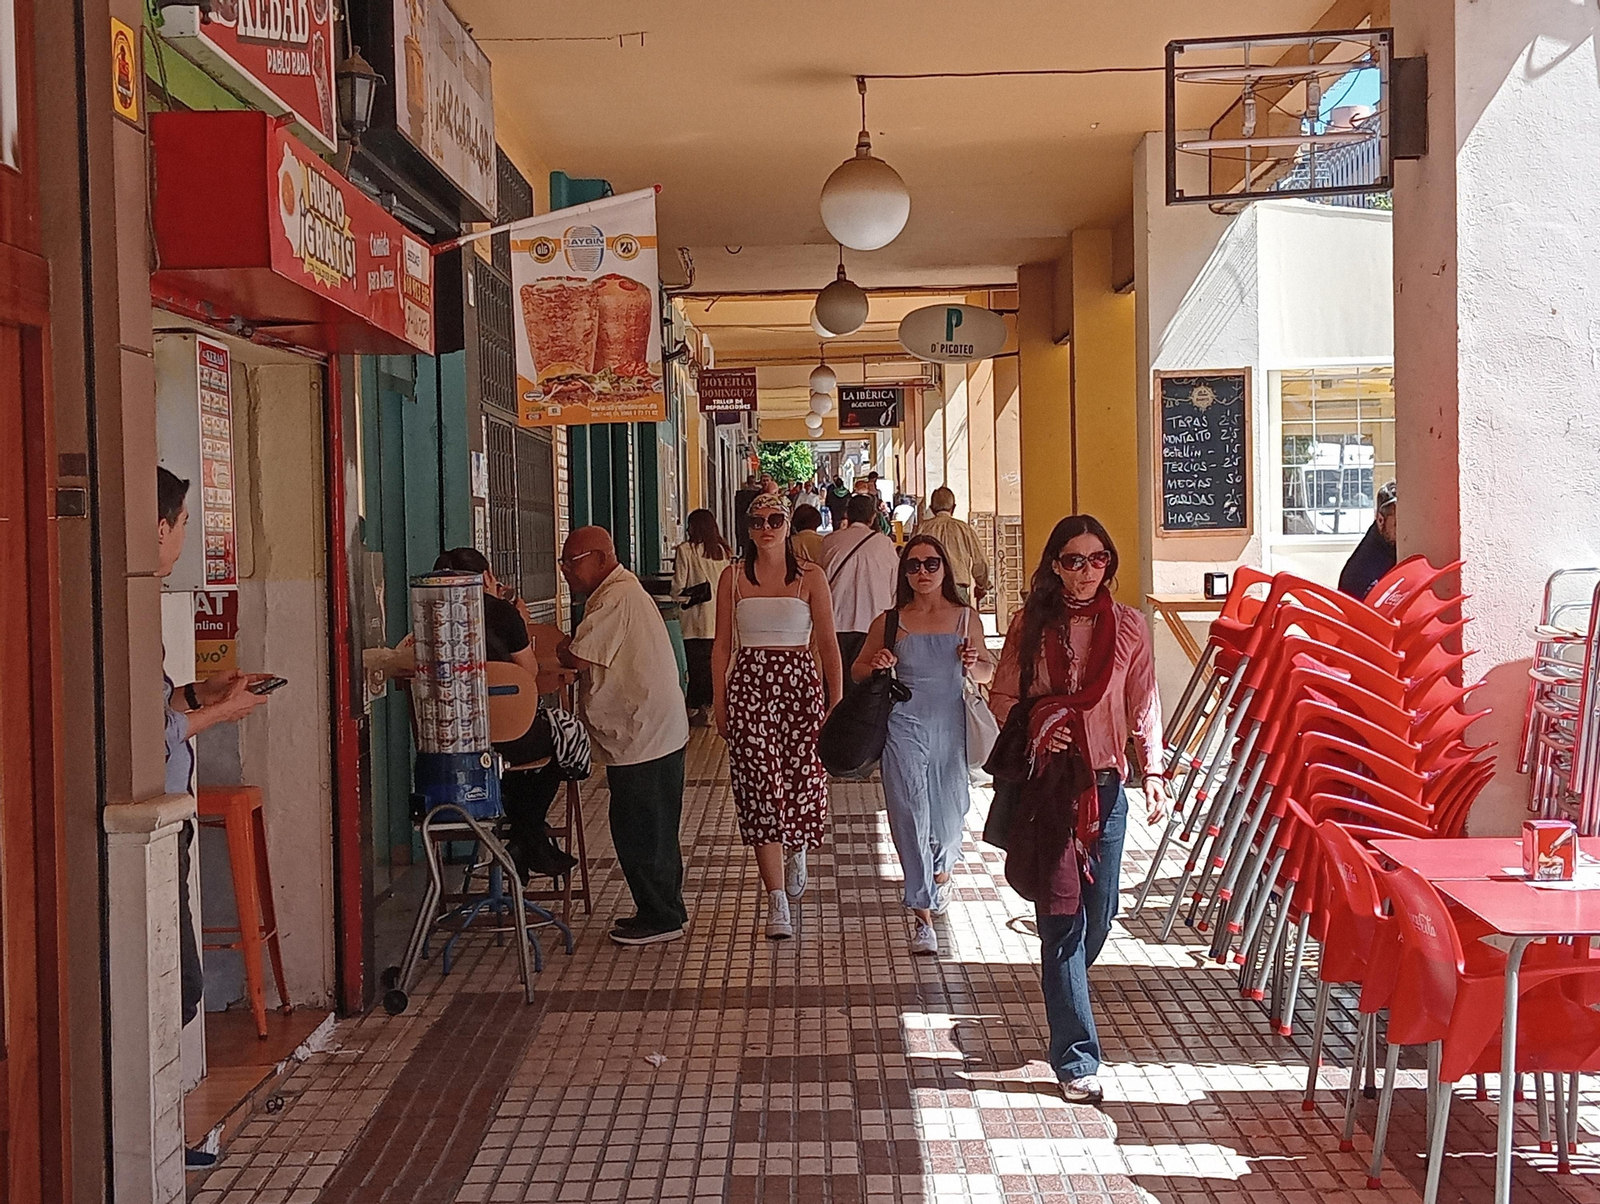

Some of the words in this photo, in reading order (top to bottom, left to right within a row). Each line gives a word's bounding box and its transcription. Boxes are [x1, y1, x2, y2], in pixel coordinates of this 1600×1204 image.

[237, 0, 309, 43] KEBAB
[266, 48, 291, 75] PABLO
[291, 51, 311, 76] RADA
[307, 166, 346, 230] HUEVO
[945, 307, 963, 342] P
[842, 391, 855, 400] LA
[856, 389, 895, 400] IBÉRICA
[1166, 415, 1208, 428] TAPAS
[1163, 459, 1207, 474] TERCIOS
[1168, 511, 1211, 524] HABAS
